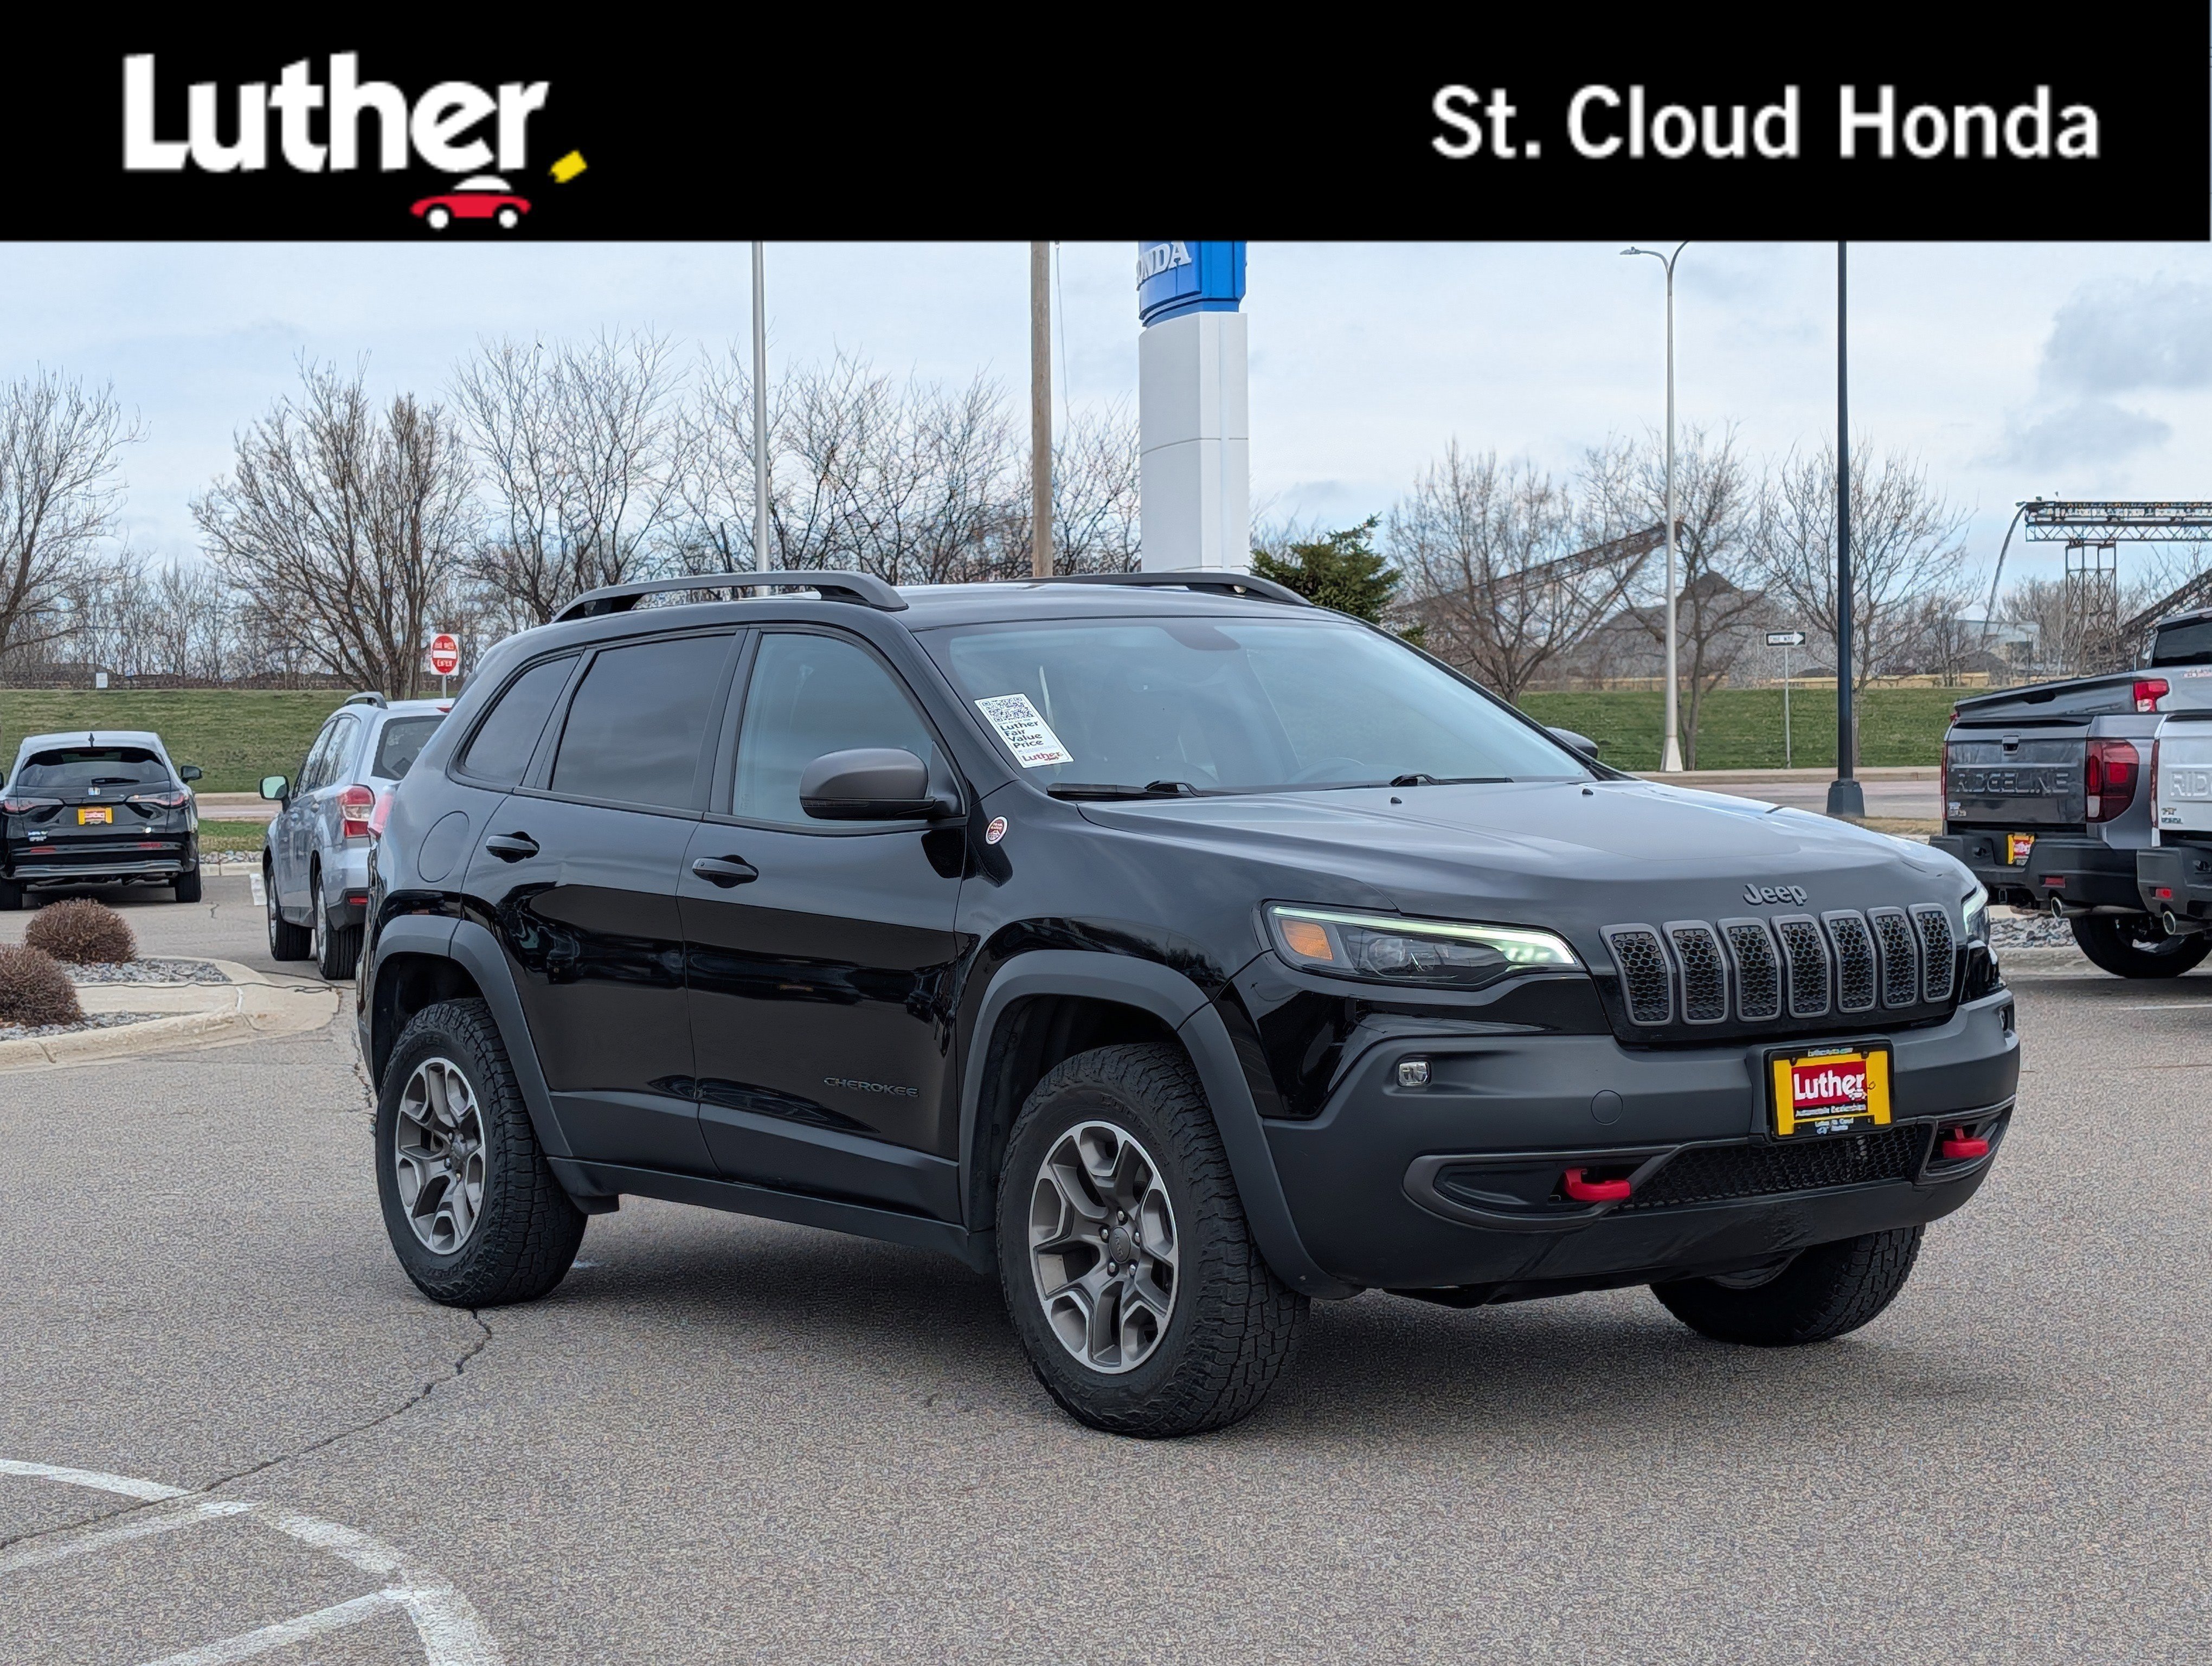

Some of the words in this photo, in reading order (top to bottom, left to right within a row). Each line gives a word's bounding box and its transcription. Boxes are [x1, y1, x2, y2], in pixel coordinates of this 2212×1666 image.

[999, 721, 1038, 731] Luther
[1008, 734, 1043, 742] Value
[1013, 740, 1044, 748] Price
[1022, 751, 1060, 761] Luther
[2170, 772, 2212, 797] RID
[1743, 883, 1808, 906] Jeep
[824, 1077, 920, 1097] CHEROKEE
[1793, 1069, 1866, 1101] Luther
